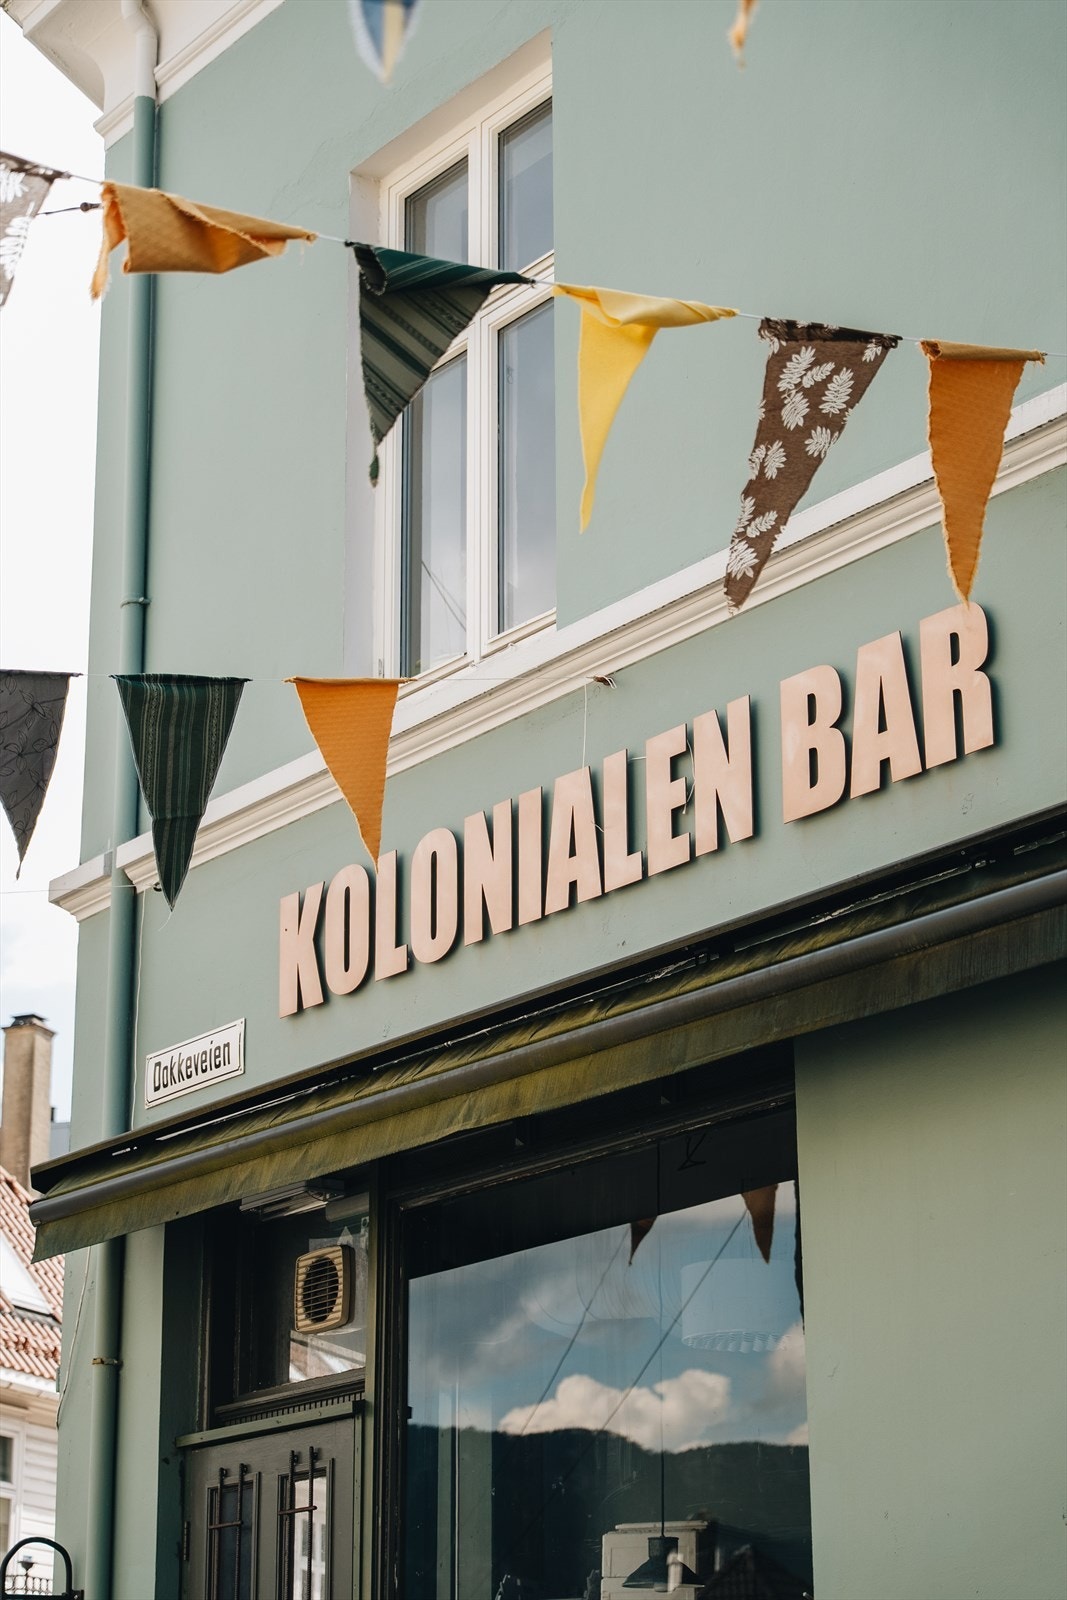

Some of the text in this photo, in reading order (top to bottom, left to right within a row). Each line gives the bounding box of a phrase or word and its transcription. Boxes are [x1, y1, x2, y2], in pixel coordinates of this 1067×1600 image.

[279, 601, 995, 1019] KOLONIALEN BAR
[153, 1040, 231, 1093] Dokkeveien
